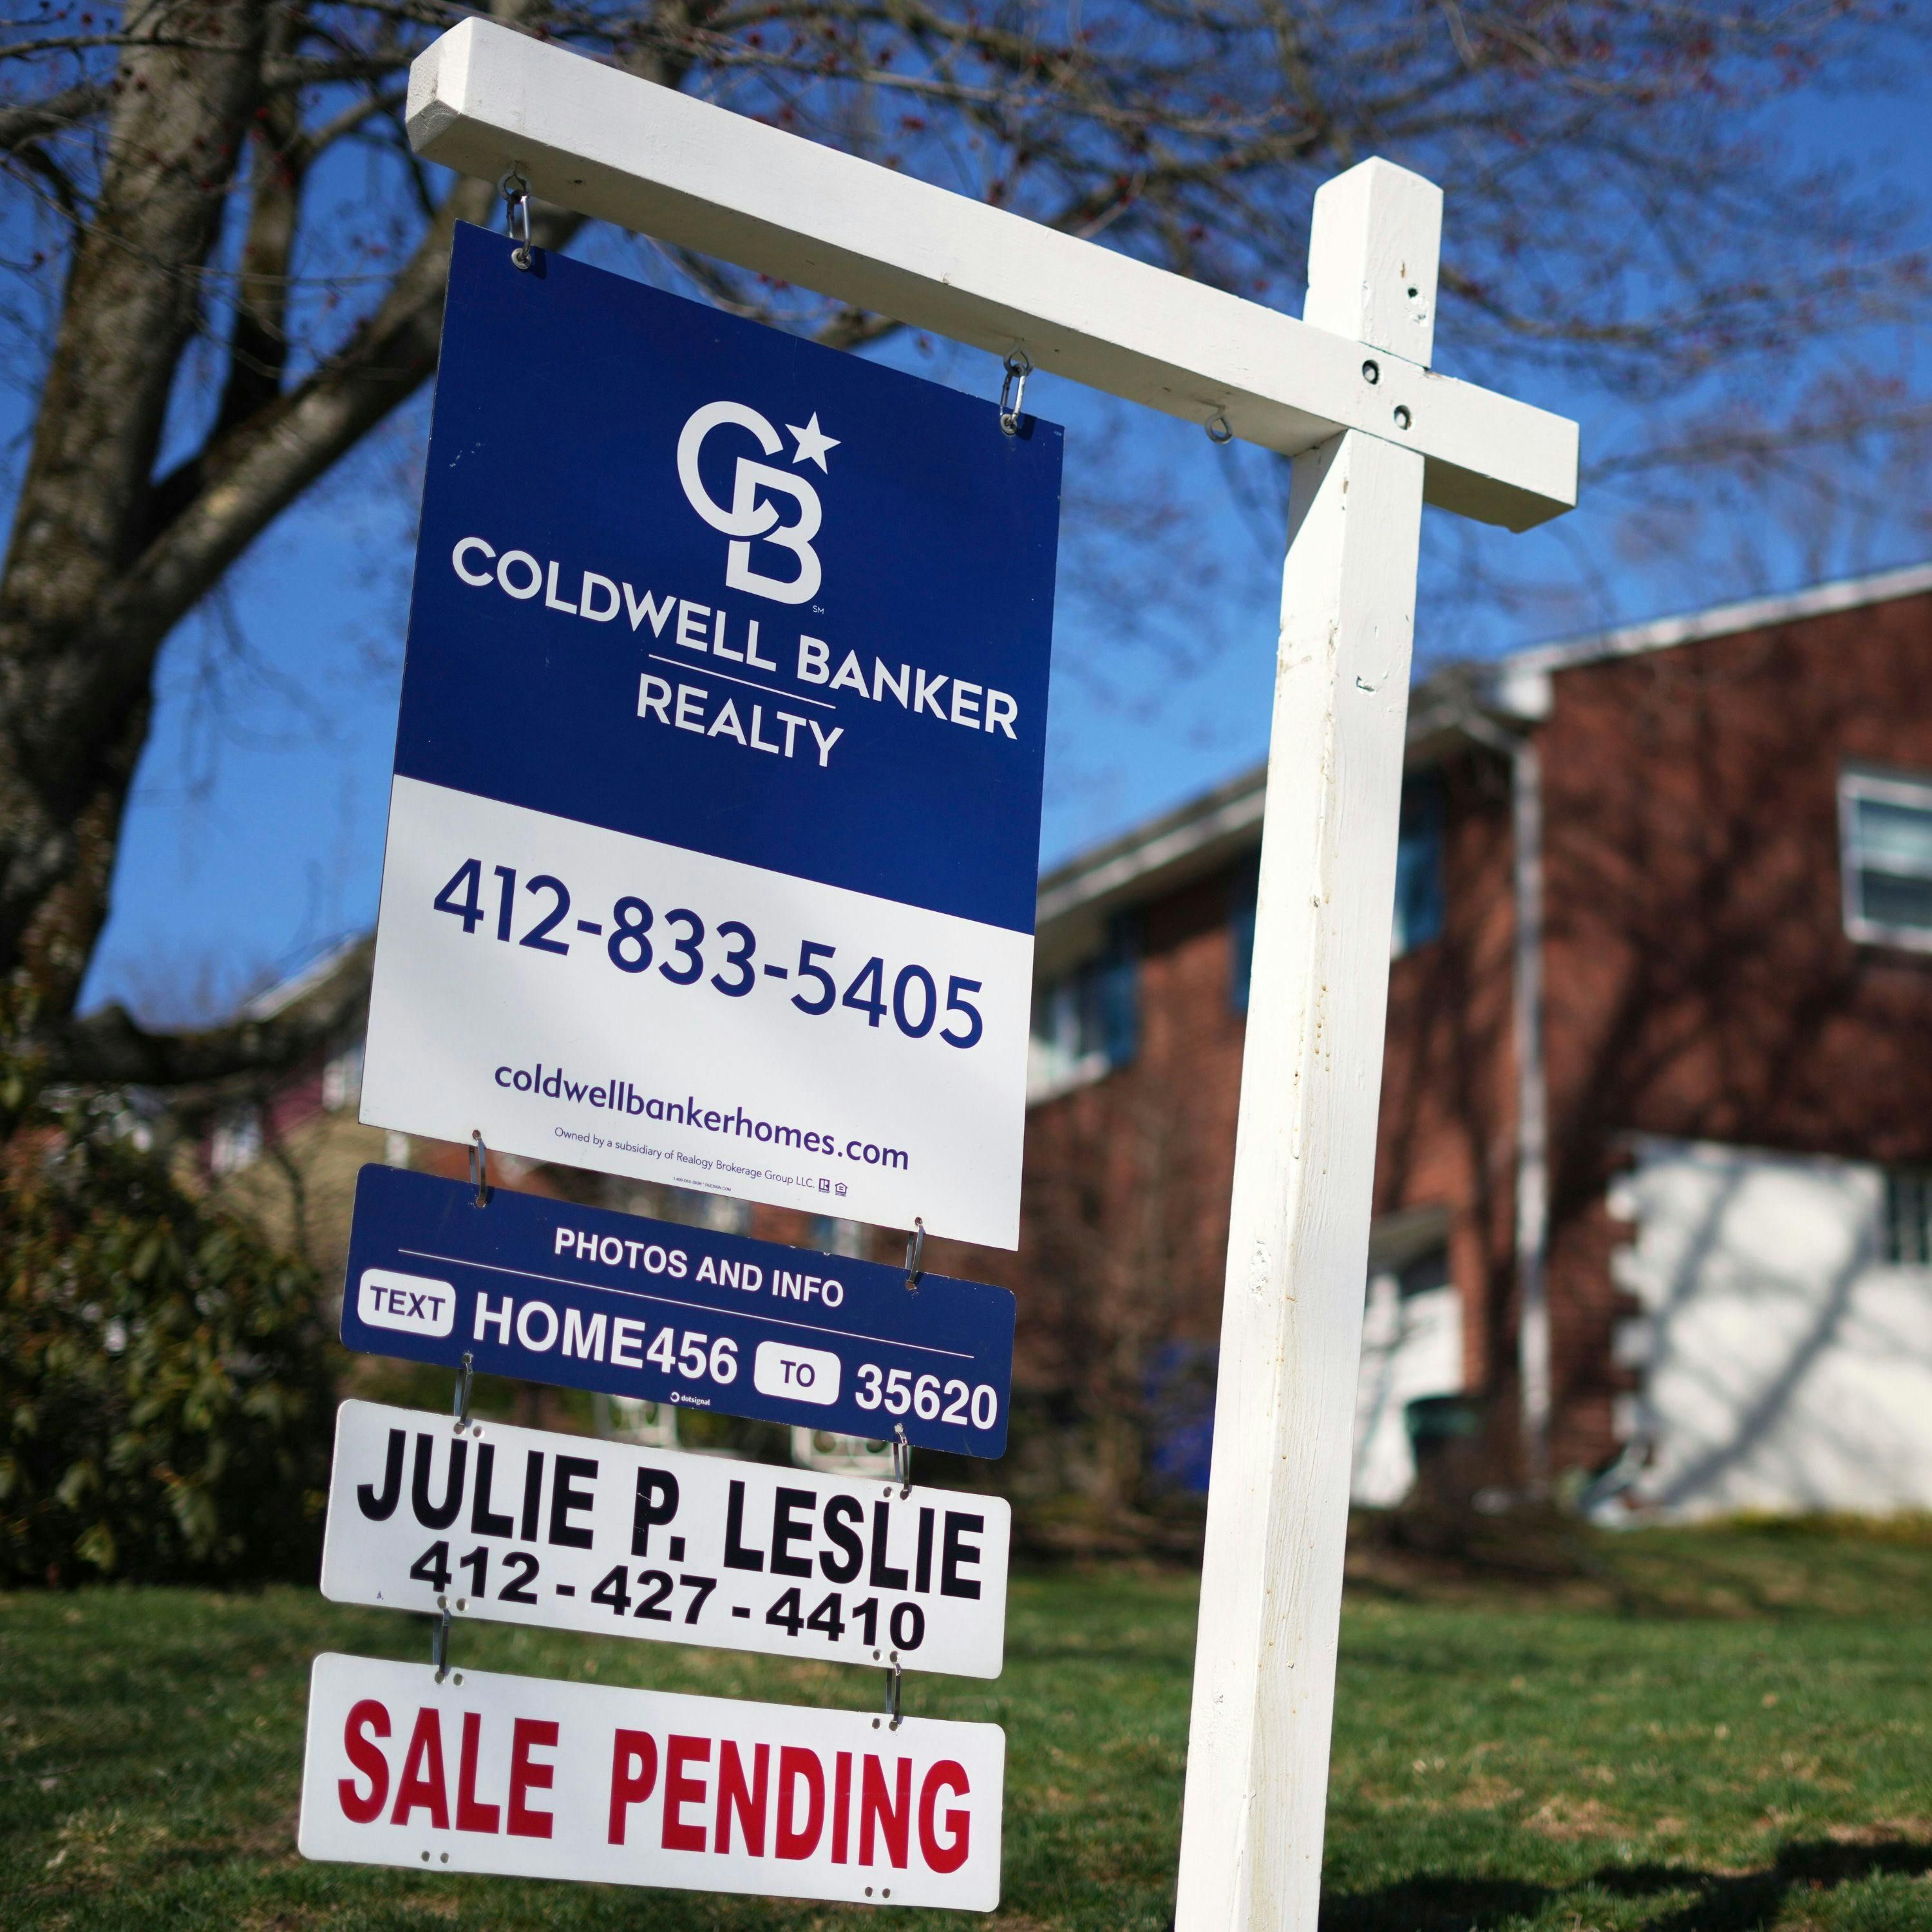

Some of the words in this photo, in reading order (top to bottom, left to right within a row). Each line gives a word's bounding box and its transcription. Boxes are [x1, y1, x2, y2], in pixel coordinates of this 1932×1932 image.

[453, 537, 776, 671] COLDWELL
[797, 635, 1018, 739] BANKER
[813, 605, 824, 614] SM
[638, 674, 844, 767] REALTY
[434, 858, 982, 1048] 412-833-5405
[495, 1064, 907, 1170] coldwellbankerhomes.com
[554, 1127, 590, 1142] Owned
[593, 1134, 605, 1148] by
[615, 1141, 662, 1159] subsidiary
[664, 1150, 674, 1160] of
[677, 1151, 714, 1170] Realogy
[716, 1160, 762, 1179] Brokerage
[764, 1170, 793, 1186] Group
[795, 1176, 815, 1188] LLC.
[555, 1228, 687, 1277] PHOTOS
[696, 1257, 762, 1291] AND
[773, 1270, 843, 1307] INFO
[370, 1286, 445, 1321] TEXT
[474, 1293, 737, 1383] HOME456
[781, 1360, 815, 1387] TO
[856, 1364, 997, 1430] 35620
[681, 1395, 710, 1406] dotsignal
[357, 1428, 598, 1549] JULIE
[631, 1467, 685, 1562] P.
[724, 1480, 984, 1600] LESLIE
[339, 1700, 558, 1837] SALE
[609, 1729, 970, 1873] PENDING
